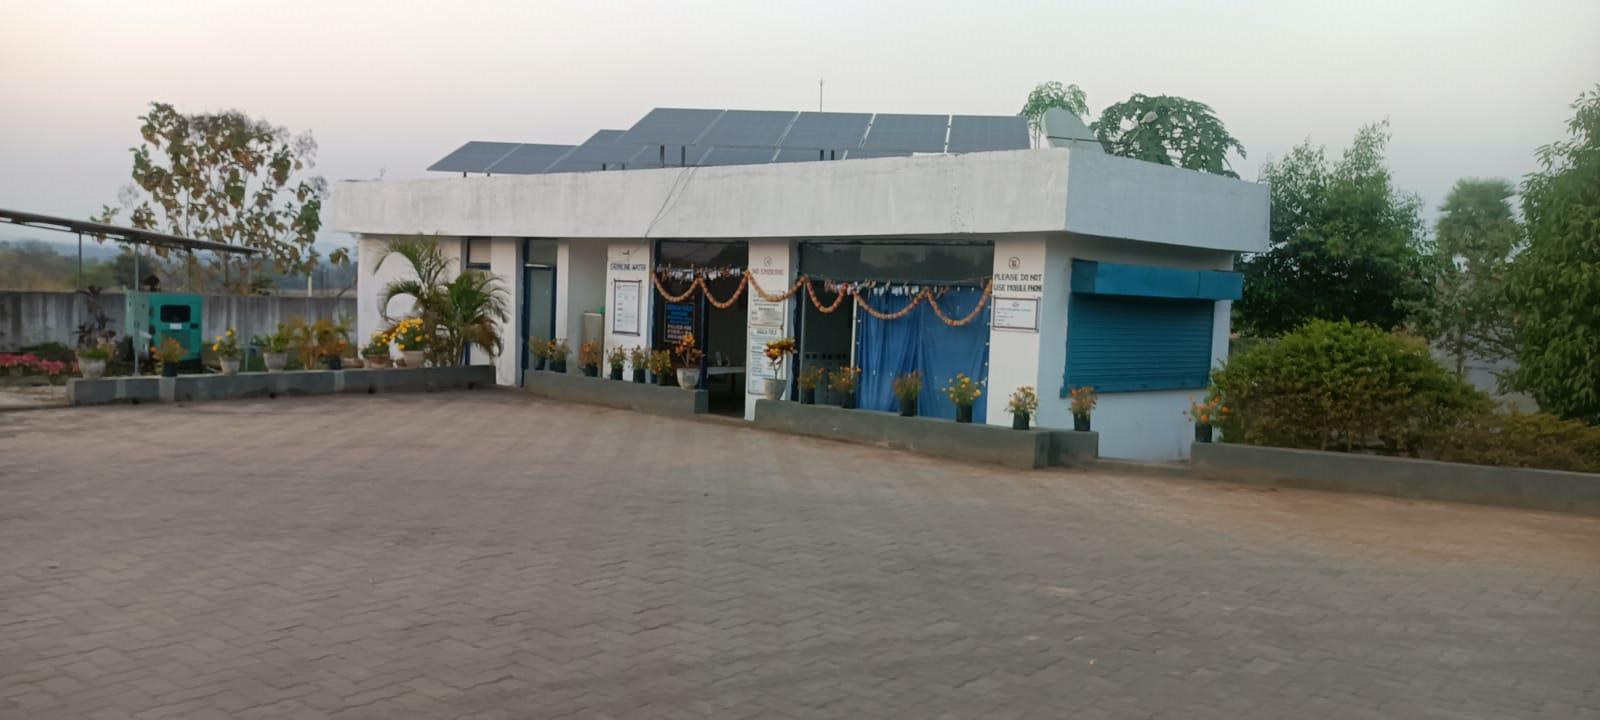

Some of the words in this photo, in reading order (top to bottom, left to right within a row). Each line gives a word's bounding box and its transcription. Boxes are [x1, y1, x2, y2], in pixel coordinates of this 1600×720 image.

[994, 273, 1018, 281] PLEASE
[1020, 273, 1028, 281] DO
[1007, 284, 1026, 292] MOBILE
